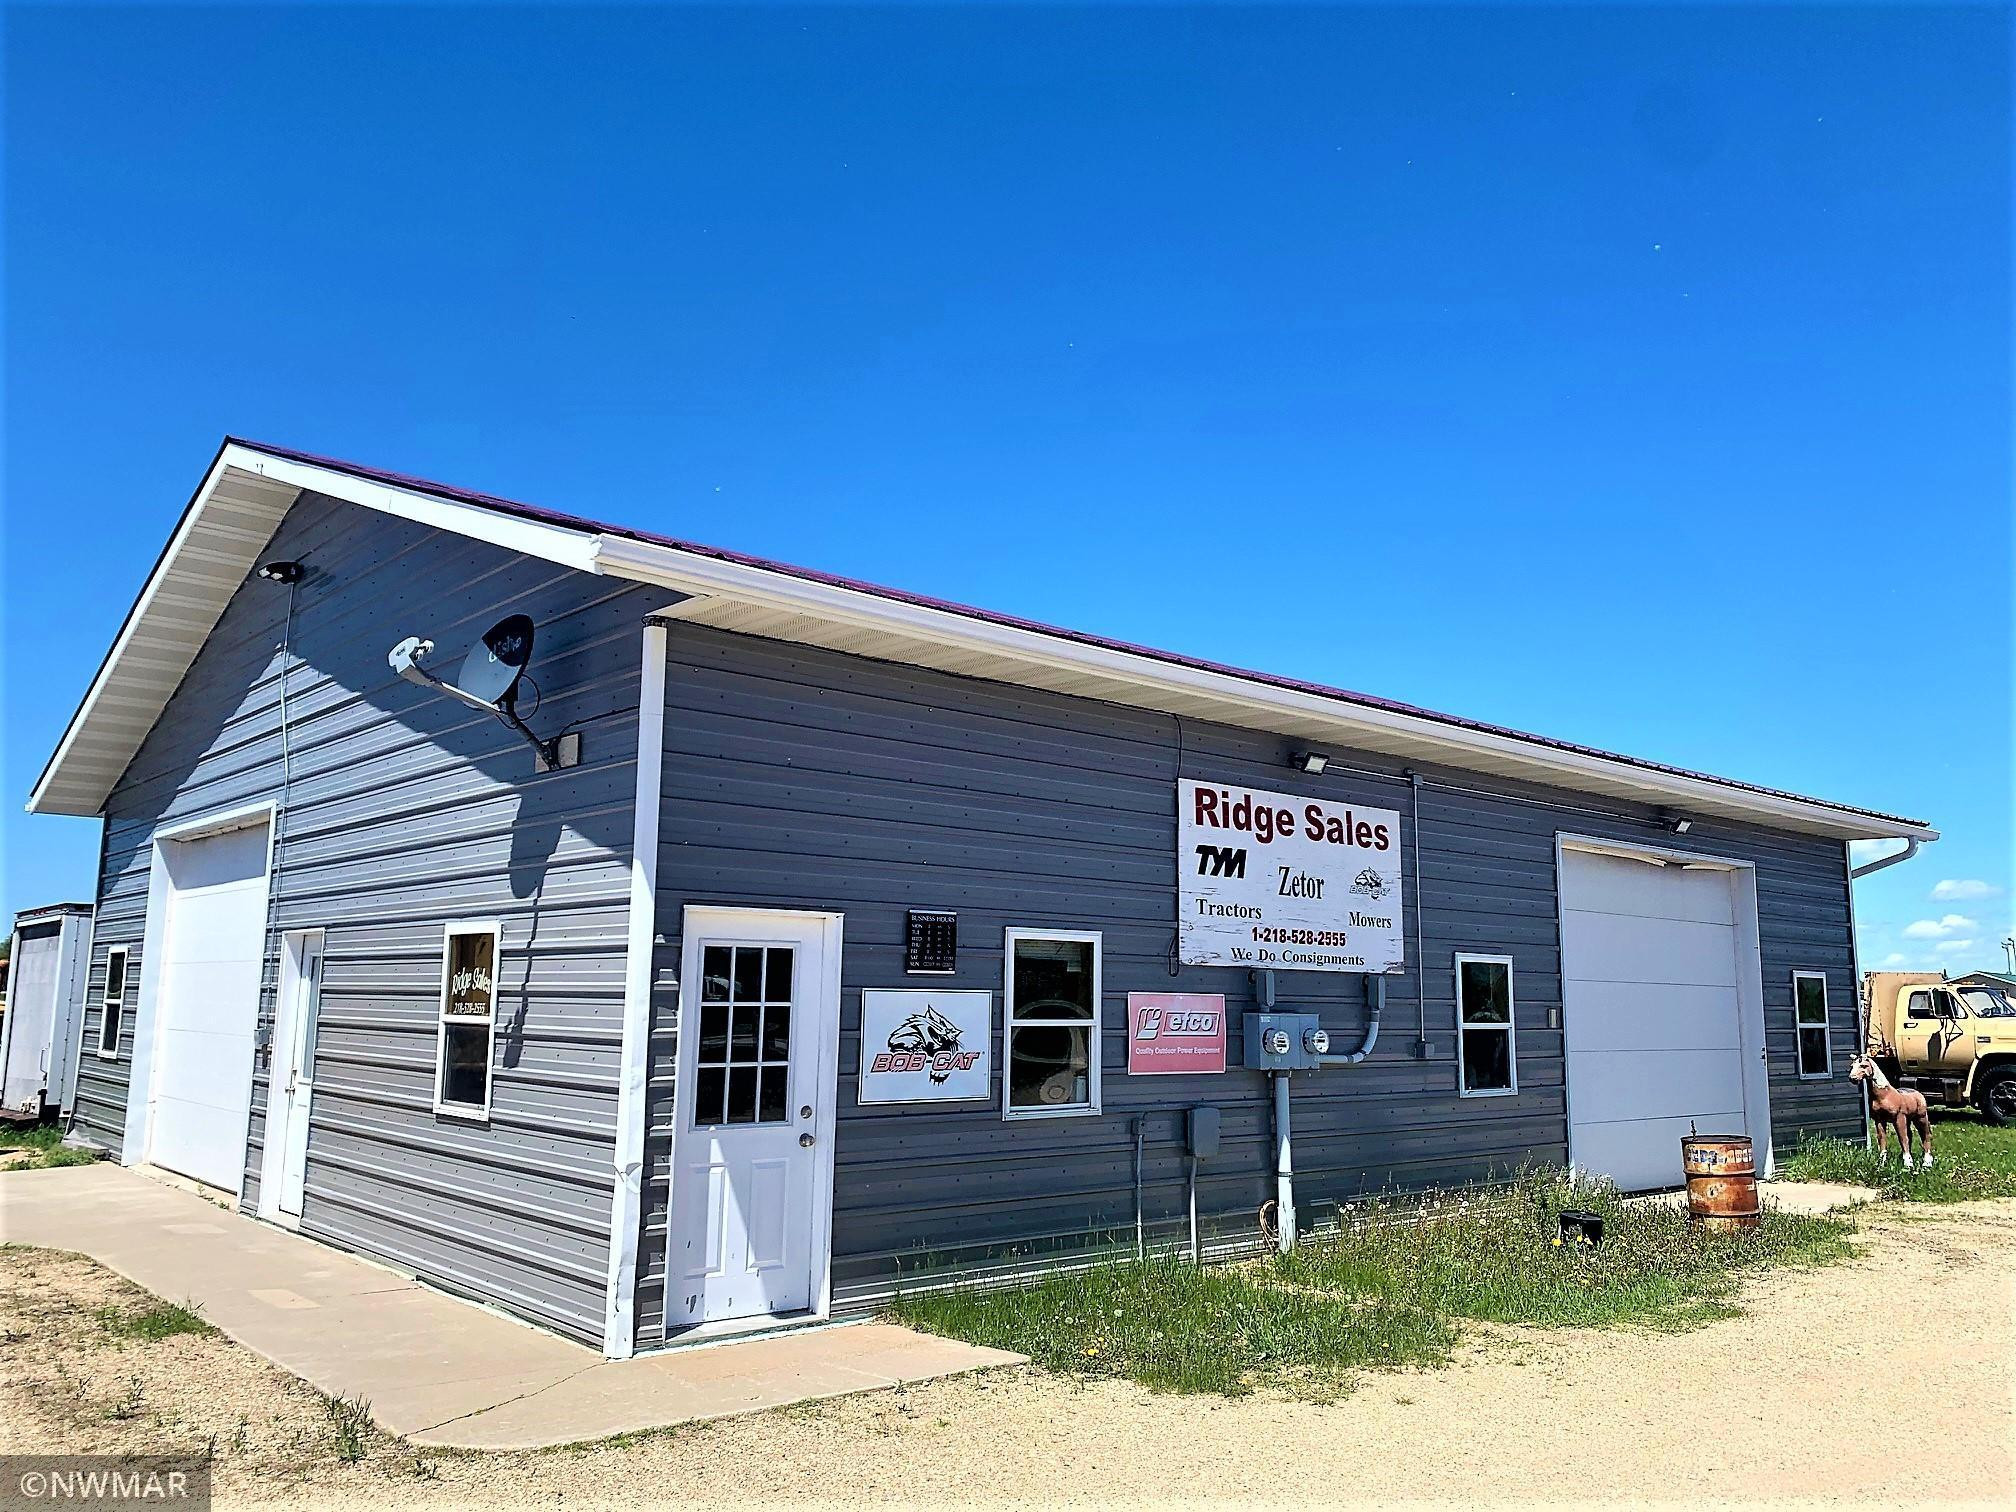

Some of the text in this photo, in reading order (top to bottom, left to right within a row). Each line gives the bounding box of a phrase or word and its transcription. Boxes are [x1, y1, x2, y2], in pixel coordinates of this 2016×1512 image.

[1194, 787, 1389, 851] Ridge Sales
[1195, 844, 1247, 879] TYM
[1278, 866, 1324, 900] Zetor
[1195, 898, 1262, 919] Tractors
[1349, 911, 1392, 928] Mowers
[1251, 926, 1346, 947] 1-218-528-2555
[1231, 947, 1365, 967] We Do Consignments
[1169, 1009, 1214, 1032] efco
[870, 1051, 980, 1073] BOB-CAT
